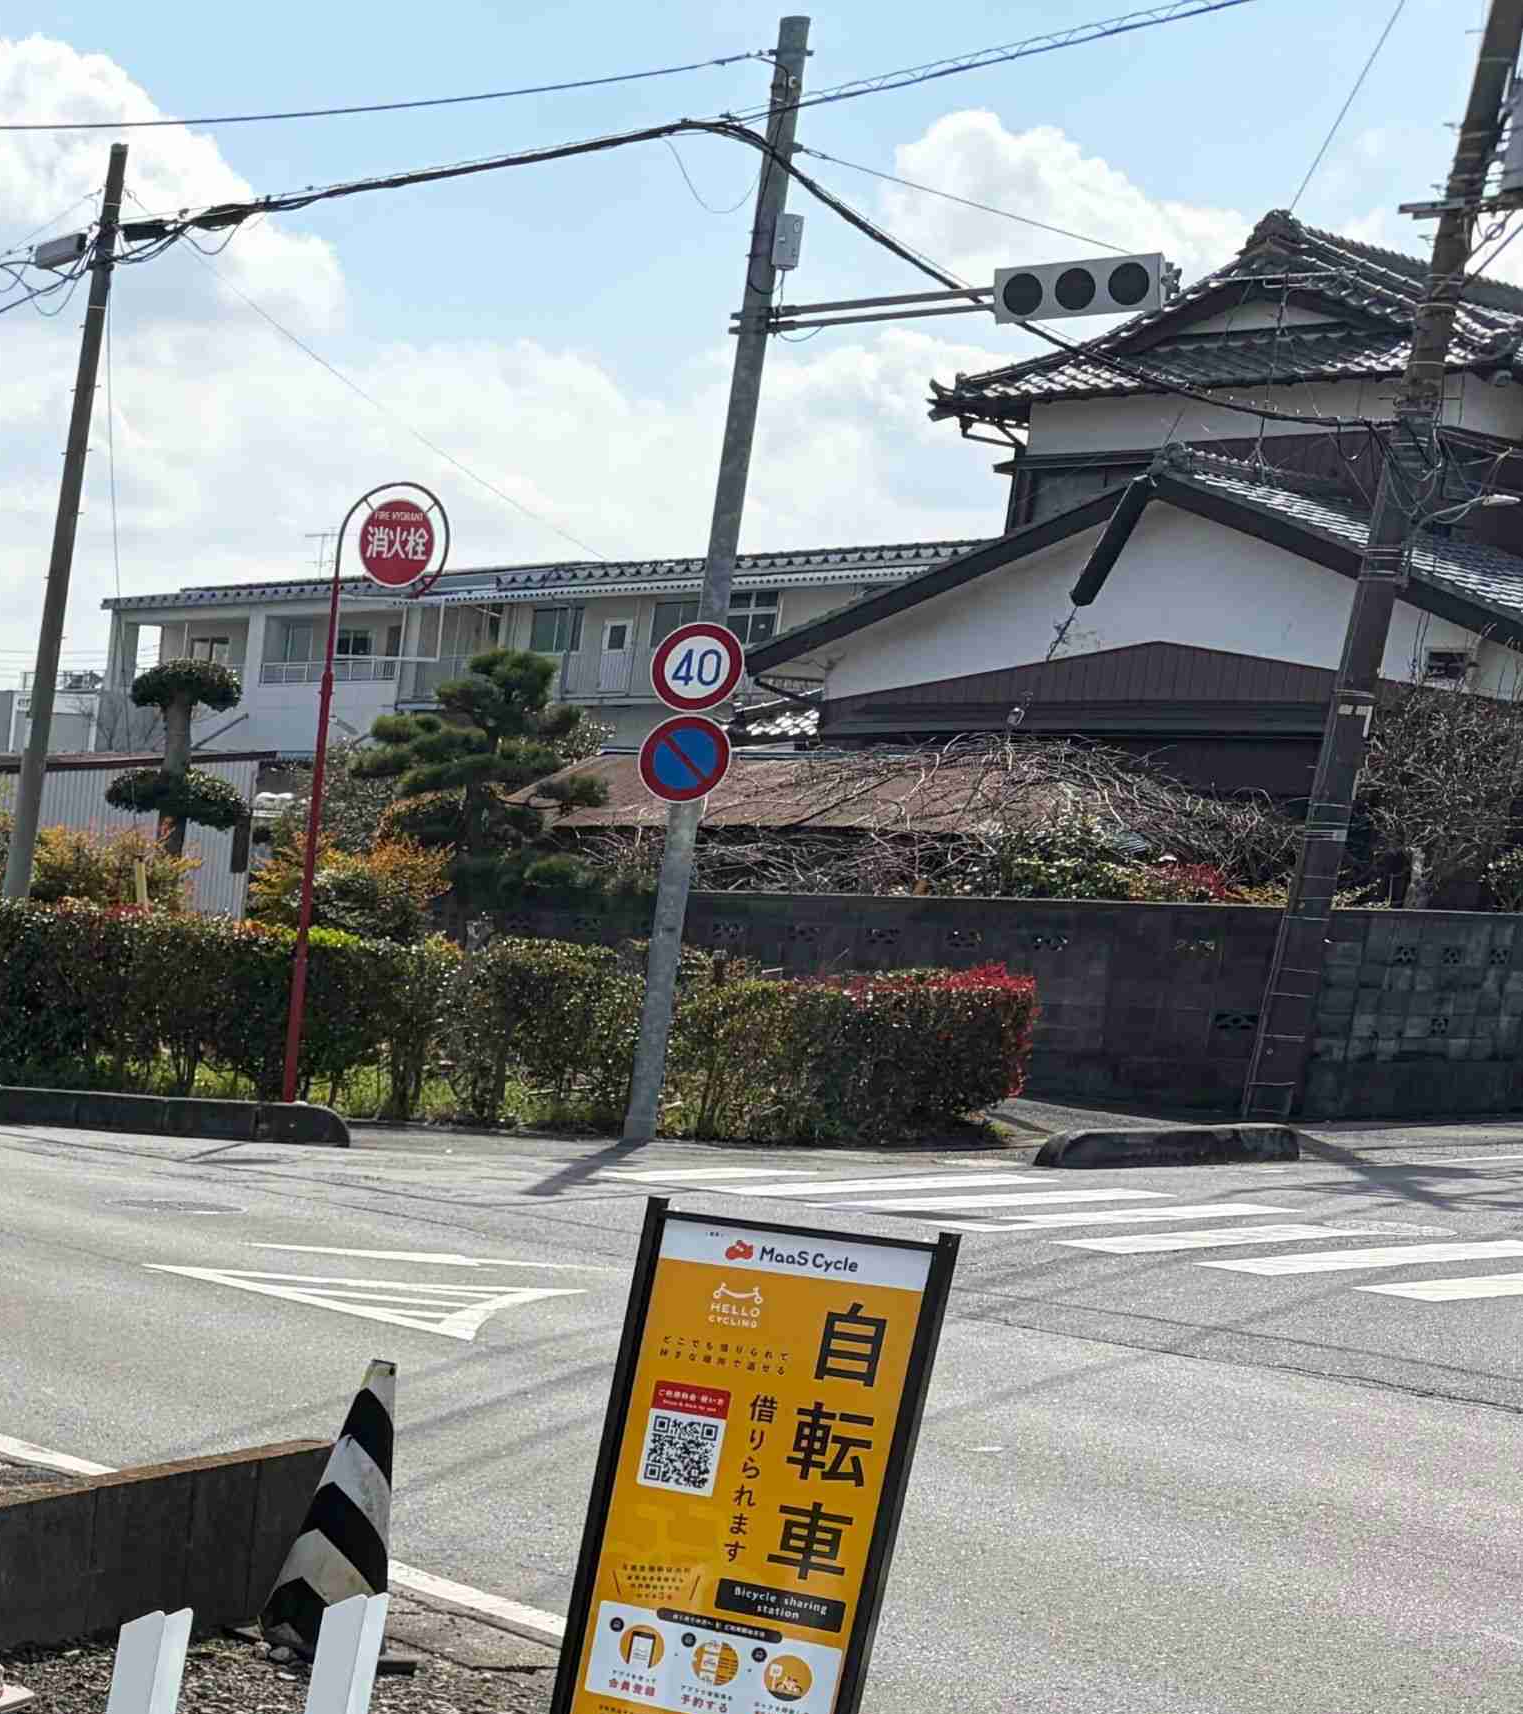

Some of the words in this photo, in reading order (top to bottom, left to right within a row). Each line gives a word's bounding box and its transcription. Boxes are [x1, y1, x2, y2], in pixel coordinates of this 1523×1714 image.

[366, 526, 429, 560] 消火栓
[671, 648, 722, 686] 40
[759, 1246, 808, 1266] MaaS
[812, 1252, 859, 1272] Cycle
[708, 1314, 758, 1328] CYCLING
[710, 1302, 760, 1318] HELLO
[766, 1301, 888, 1581] 自転車
[724, 1391, 778, 1563] 借りられます
[734, 1586, 778, 1602] Bicycle
[784, 1597, 828, 1616] sharing
[757, 1604, 800, 1619] station
[681, 1694, 728, 1713] 予約する
